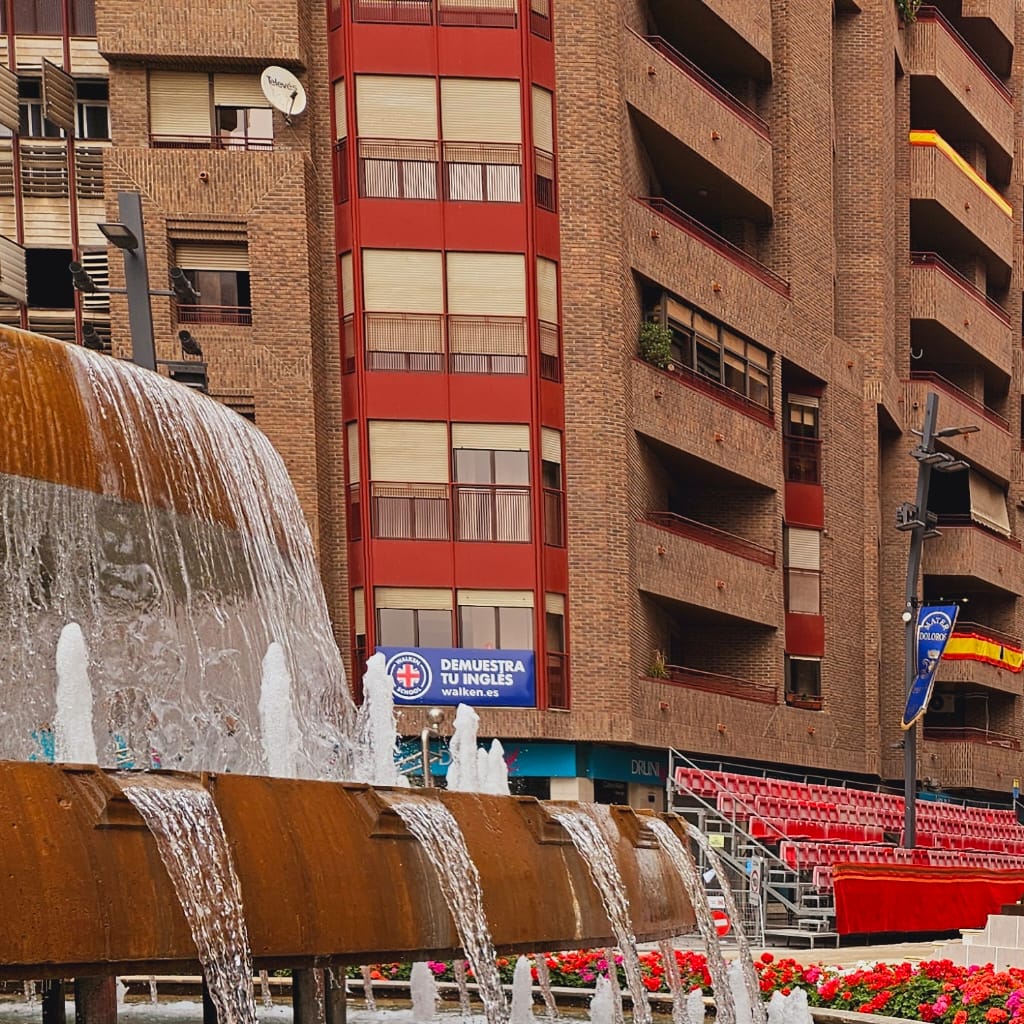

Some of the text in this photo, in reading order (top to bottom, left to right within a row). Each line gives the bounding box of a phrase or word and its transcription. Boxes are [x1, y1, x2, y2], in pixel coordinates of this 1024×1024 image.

[919, 632, 947, 641] DOLOROS
[395, 656, 421, 666] WALKEN
[440, 659, 525, 673] DEMUESTRA
[440, 672, 460, 685] TU
[396, 686, 422, 696] SCHOOL
[441, 687, 499, 697] walken.es
[631, 760, 660, 776] DRUNI
